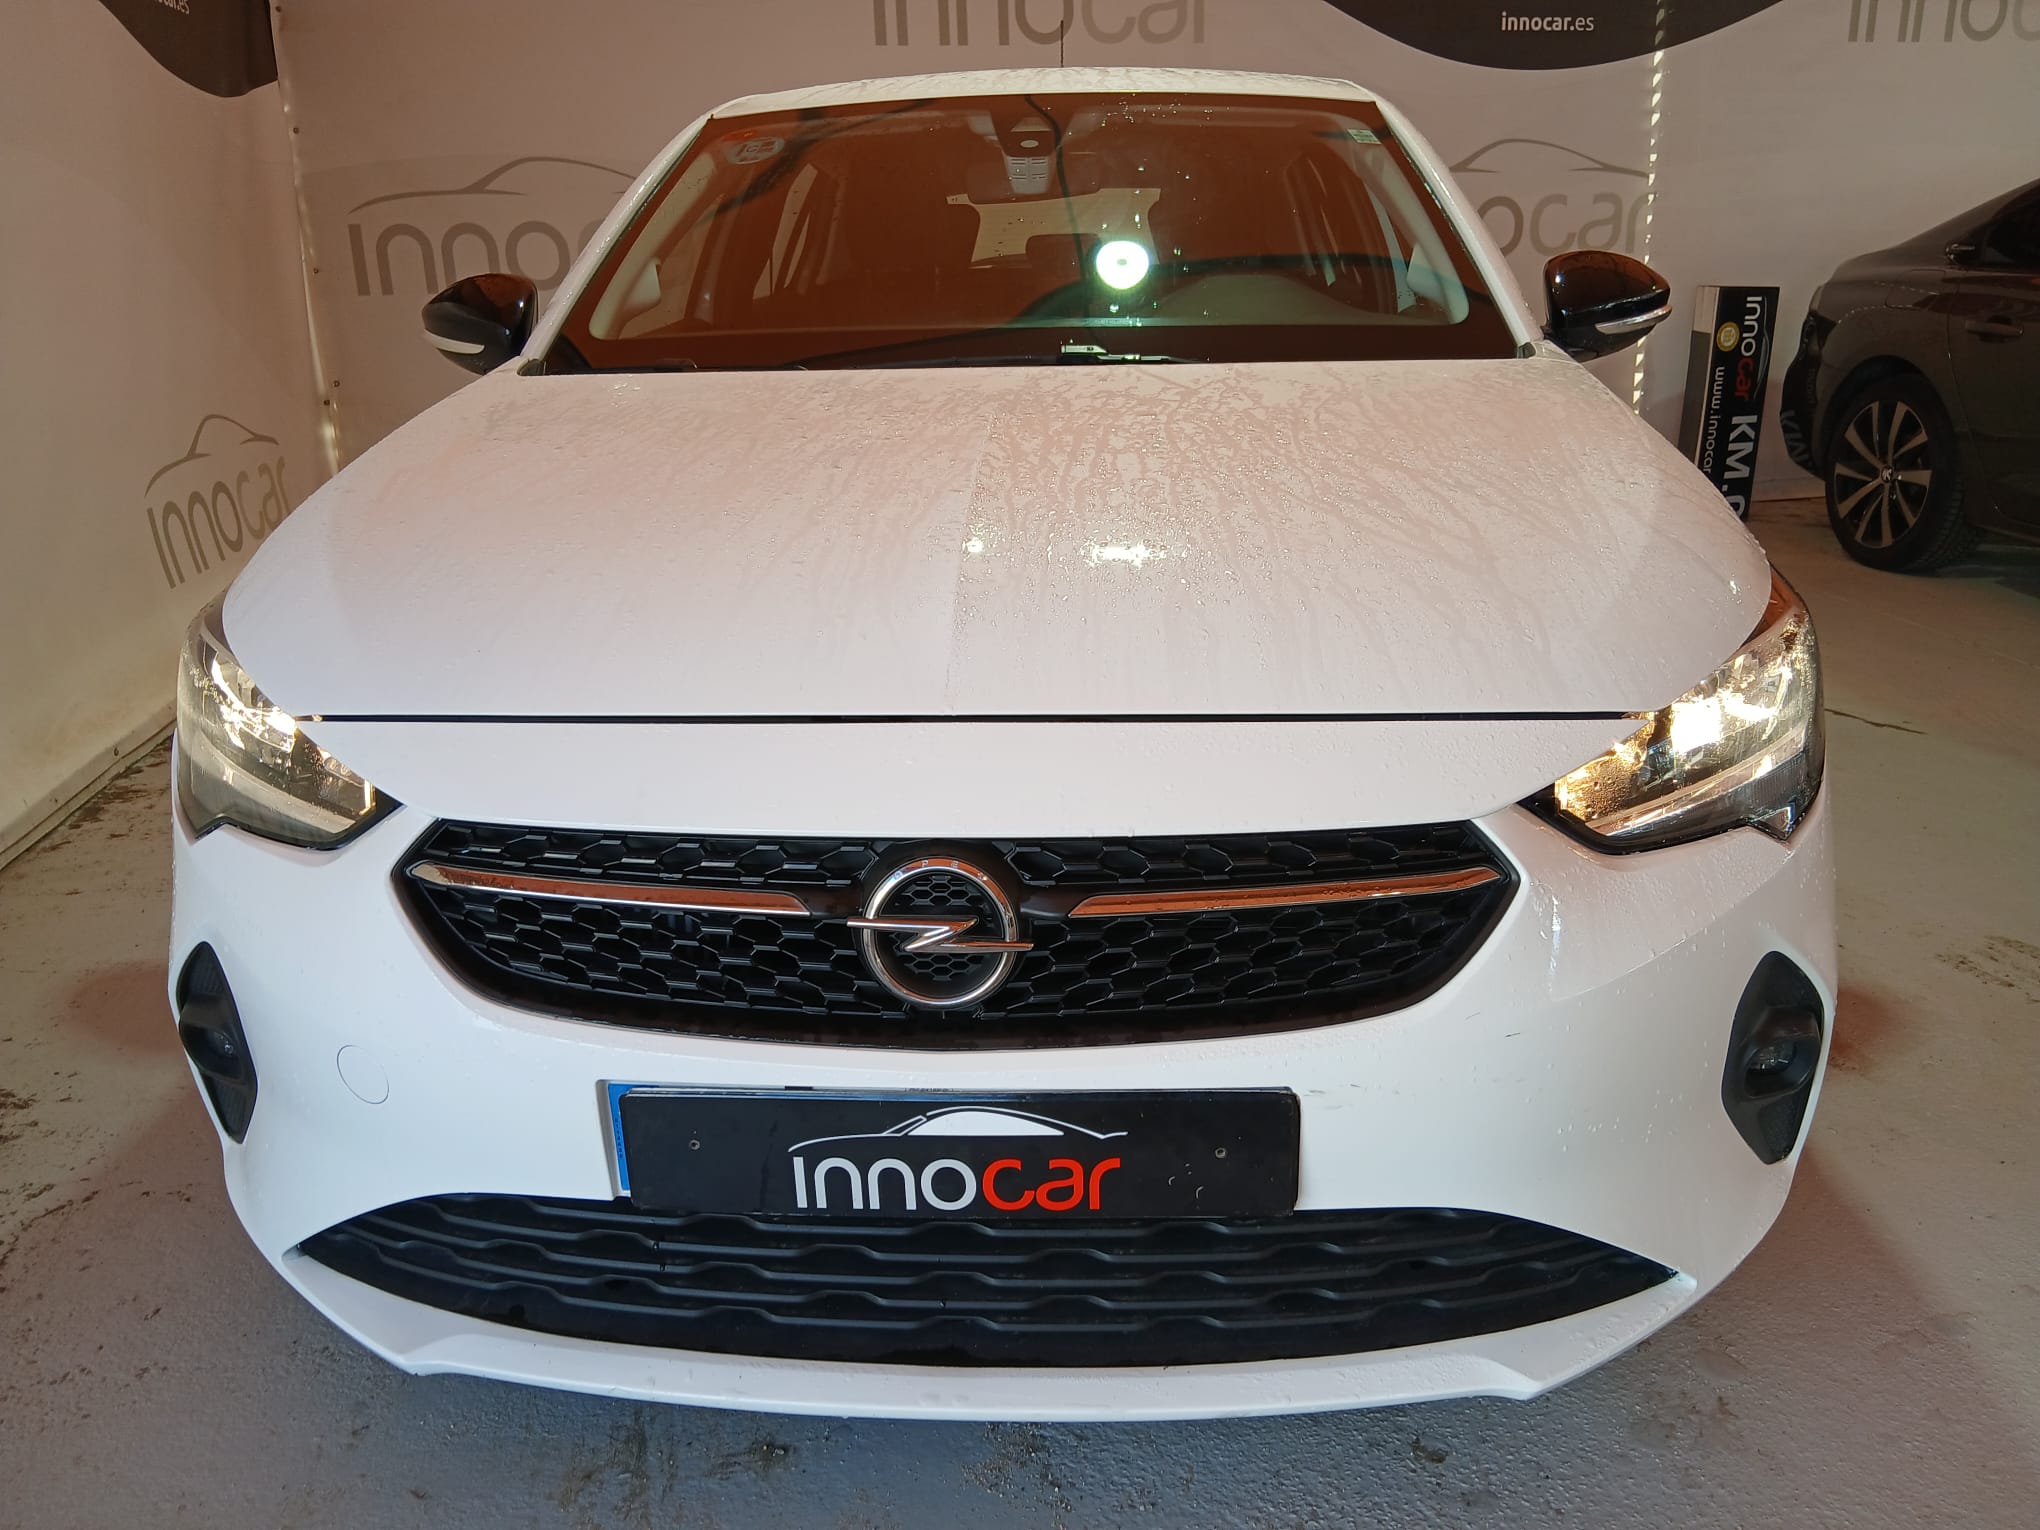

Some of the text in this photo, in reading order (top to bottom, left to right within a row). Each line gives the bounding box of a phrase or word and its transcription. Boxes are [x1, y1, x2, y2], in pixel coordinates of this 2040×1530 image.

[1501, 10, 1595, 31] innocar.es
[1733, 295, 1763, 401] innocar
[146, 455, 291, 589] innocar
[793, 1156, 1121, 1211] innocar
